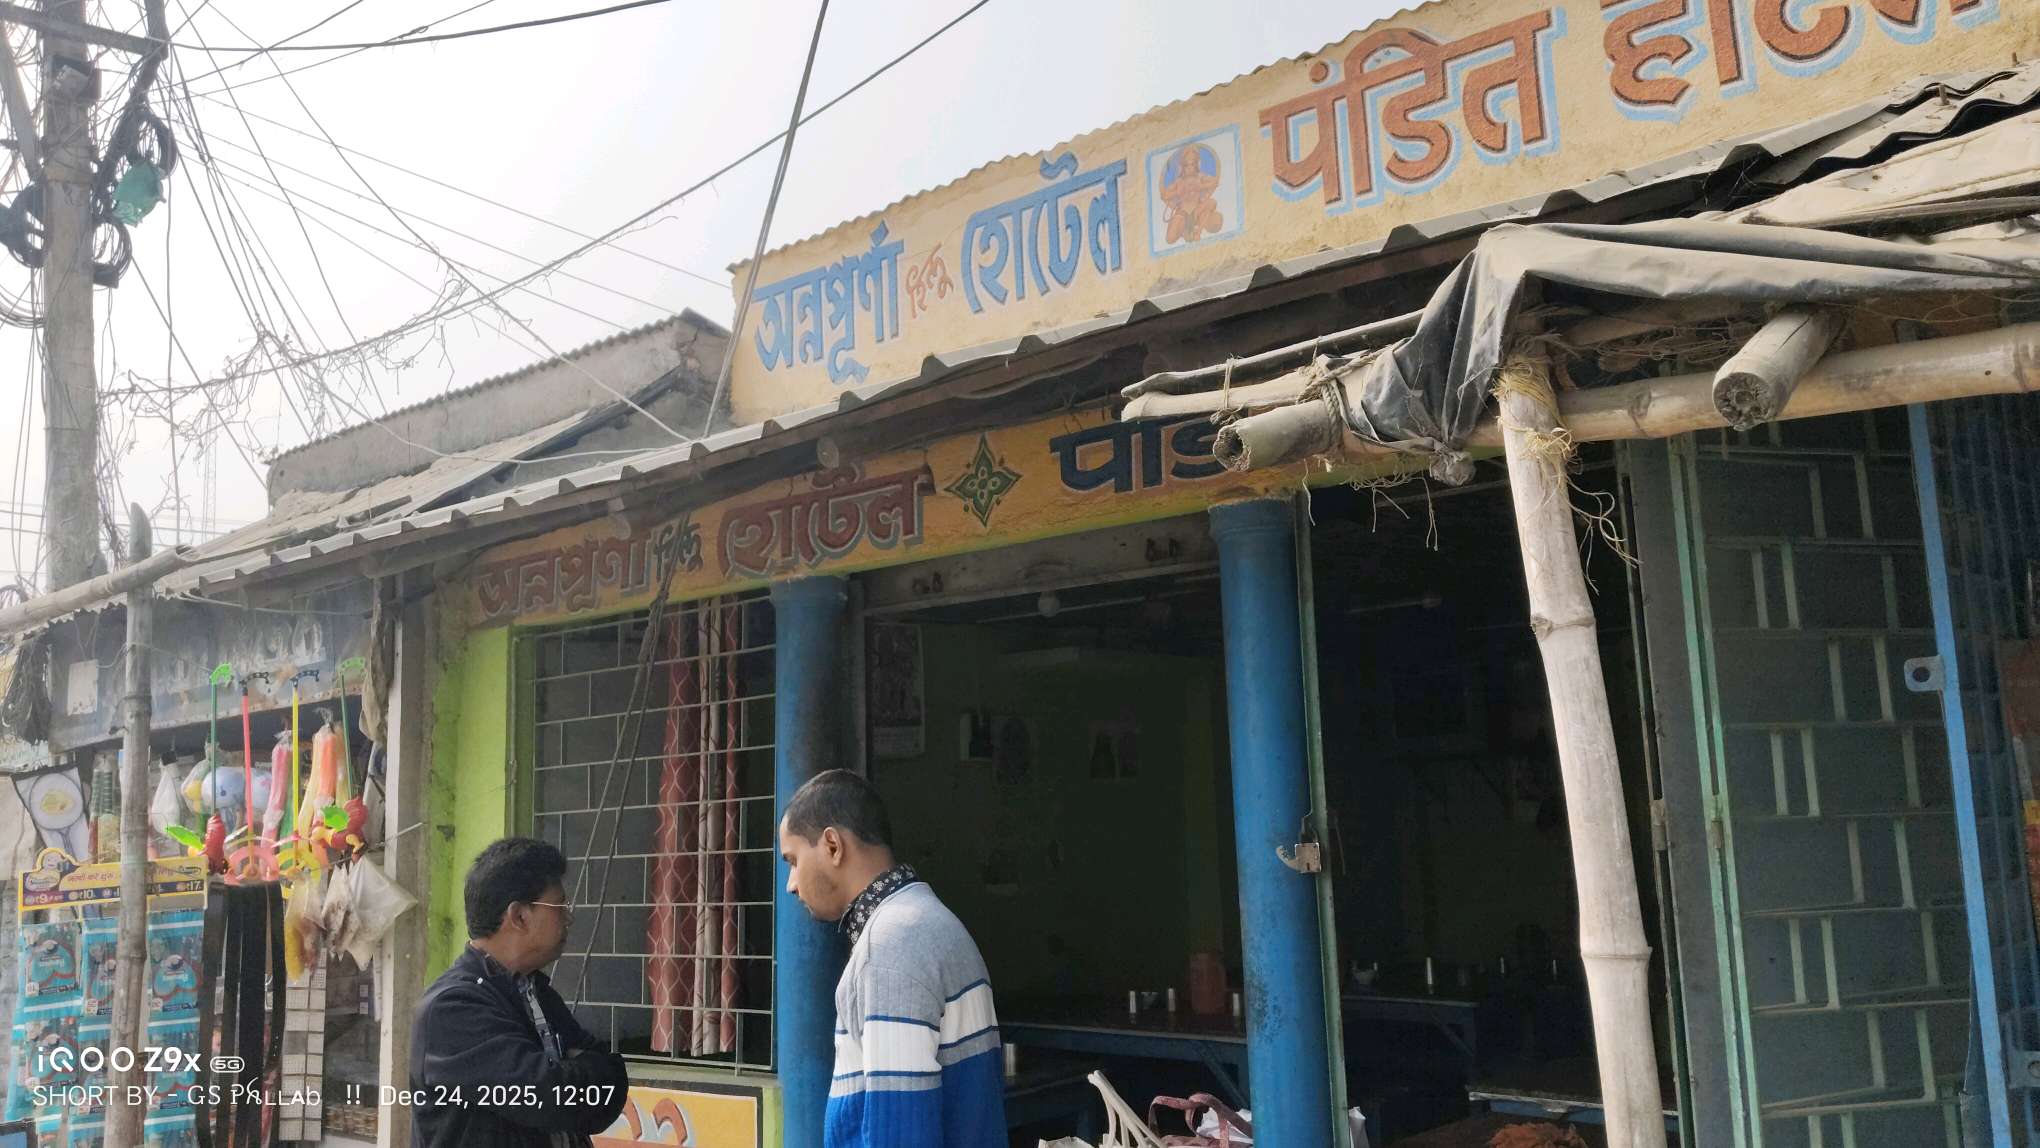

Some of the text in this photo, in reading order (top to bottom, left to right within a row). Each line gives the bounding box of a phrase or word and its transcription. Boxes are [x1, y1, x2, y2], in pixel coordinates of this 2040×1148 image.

[1259, 8, 1564, 212] पंडित
[751, 219, 904, 384] অন্নপূর্ণা
[961, 152, 1127, 314] হোটেল
[716, 462, 933, 577] হোটেল
